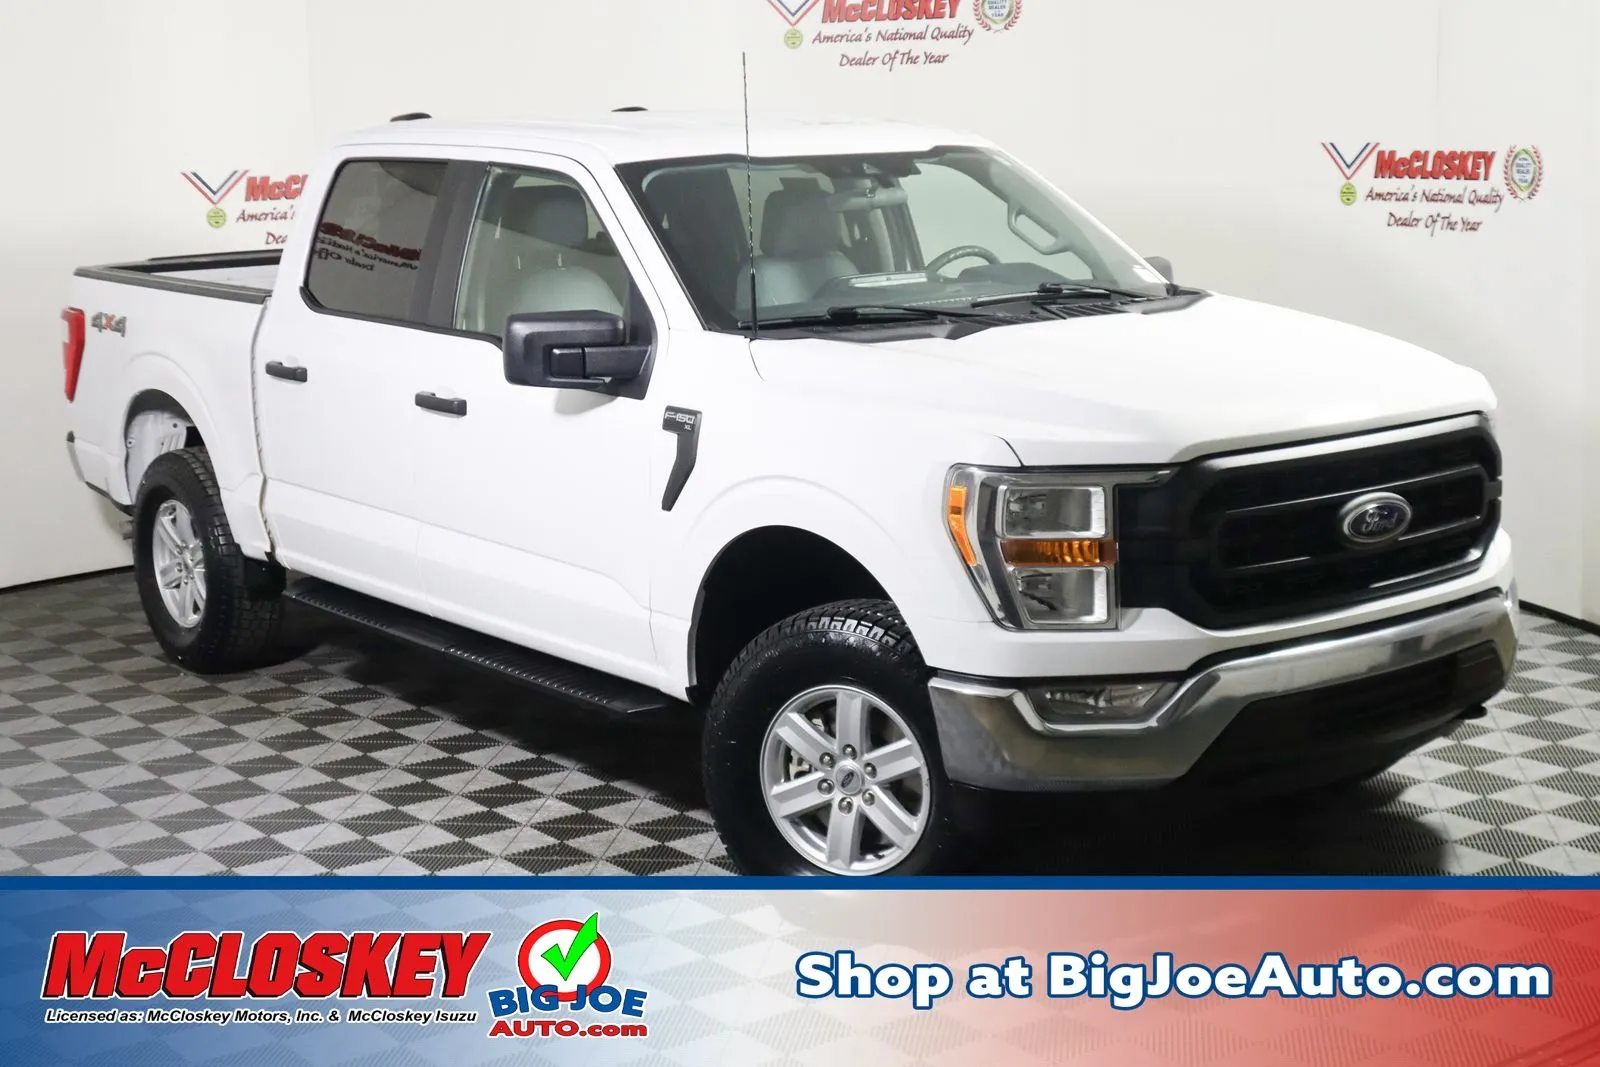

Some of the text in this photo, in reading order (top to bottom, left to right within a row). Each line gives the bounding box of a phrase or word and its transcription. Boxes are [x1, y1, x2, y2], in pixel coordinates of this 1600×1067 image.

[822, 0, 961, 23] McCLOSKEY
[812, 26, 872, 44] America's
[876, 24, 930, 42] National
[930, 23, 975, 46] Quality
[839, 48, 950, 73] Dealer Of The Year
[1374, 150, 1497, 181] McCLOSKEY
[1365, 184, 1418, 202] America's
[1420, 185, 1467, 204] National
[1467, 187, 1505, 213] Quality
[1387, 209, 1483, 238] Dealer Of The Year
